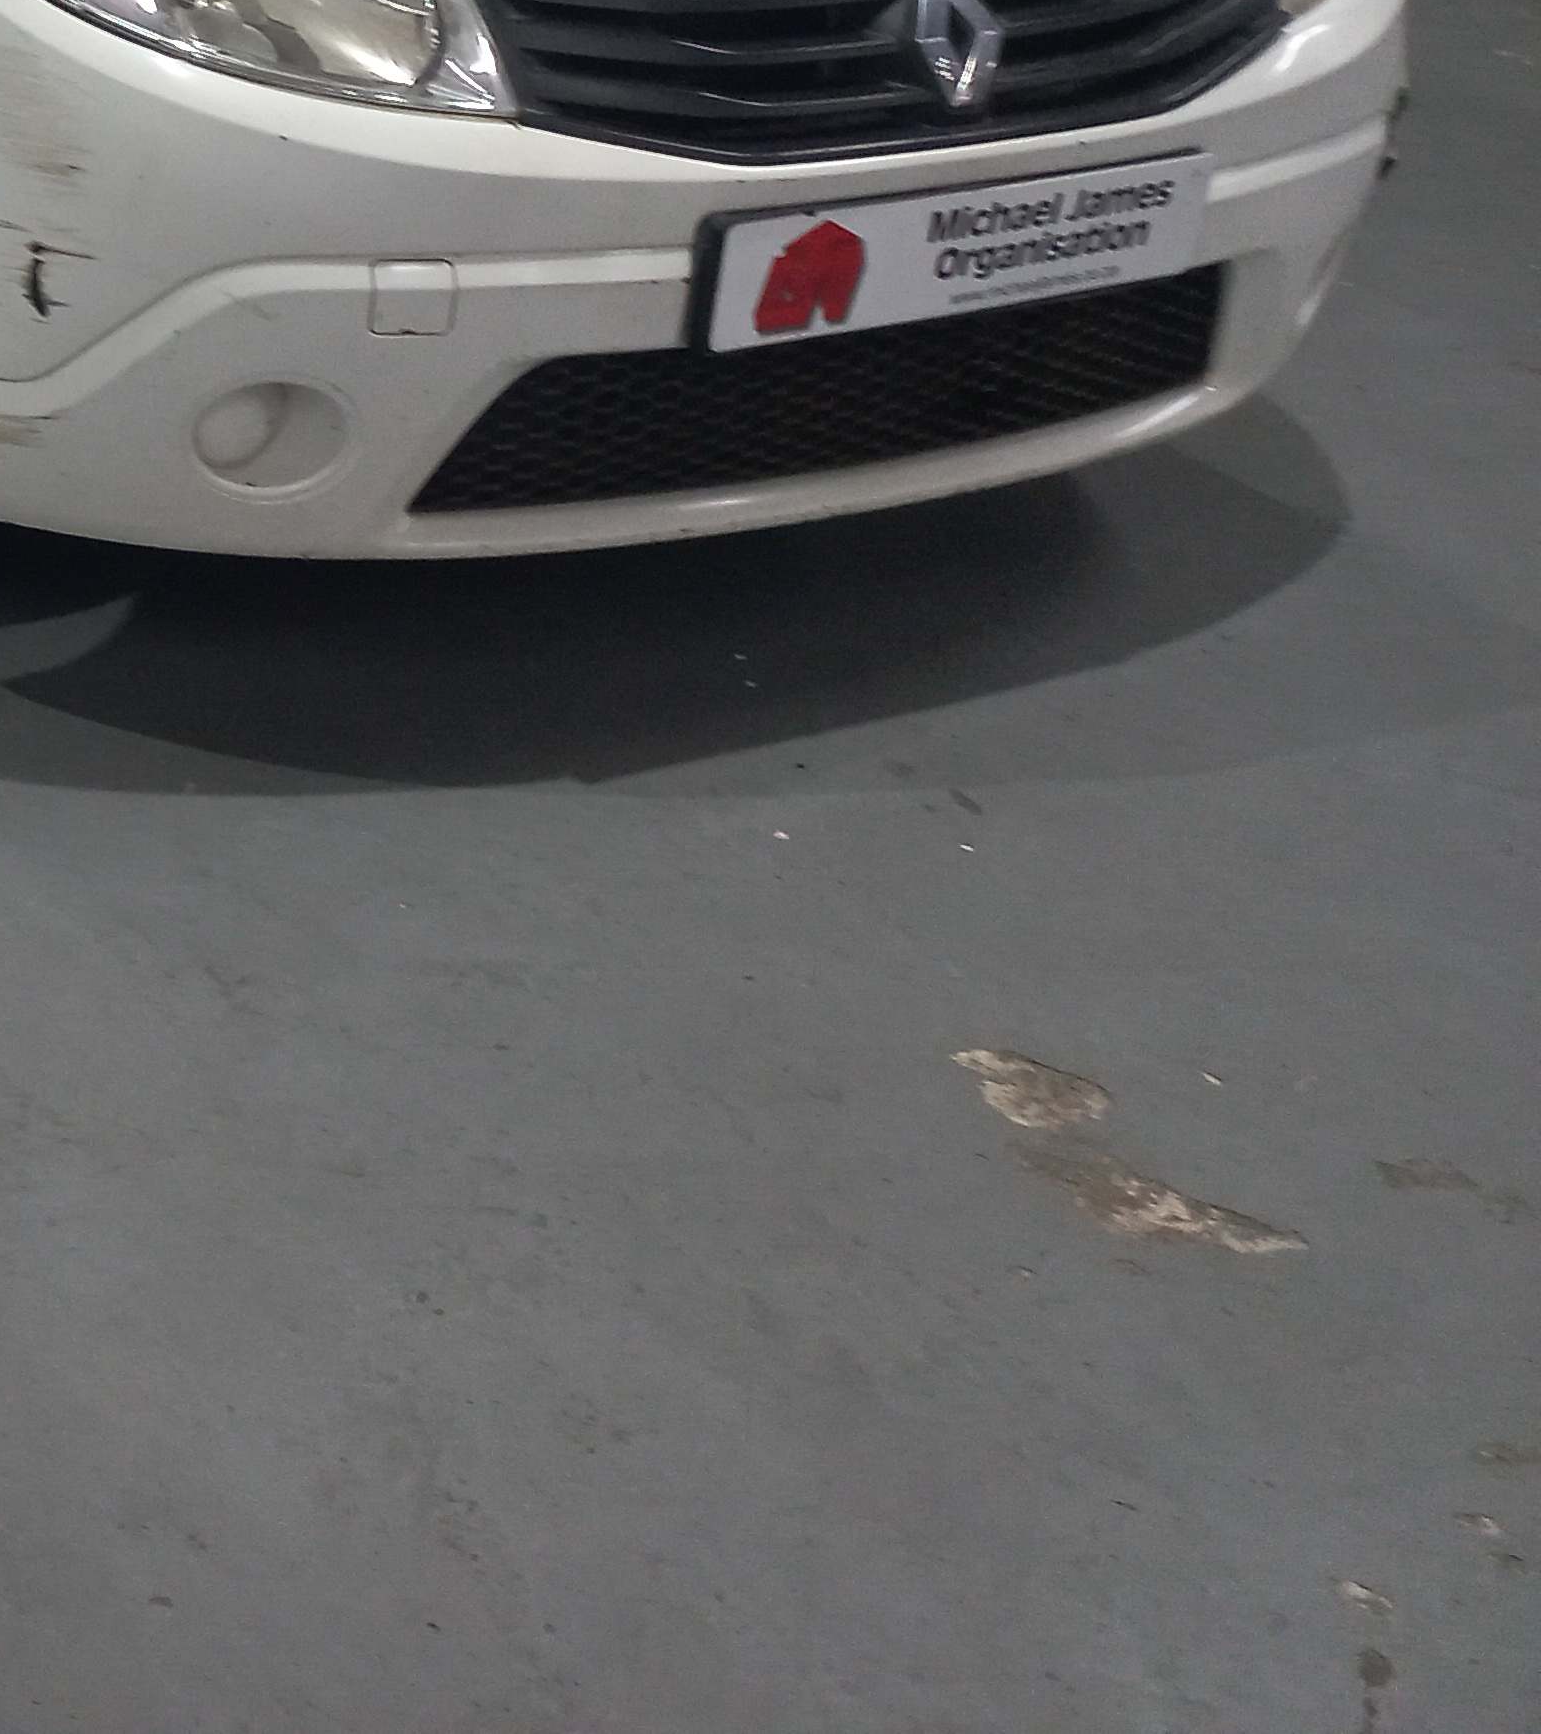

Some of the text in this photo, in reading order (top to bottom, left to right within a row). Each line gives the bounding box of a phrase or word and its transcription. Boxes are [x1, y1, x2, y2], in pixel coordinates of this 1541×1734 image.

[925, 179, 1177, 244] Michael James
[933, 219, 1153, 280] Organisation
